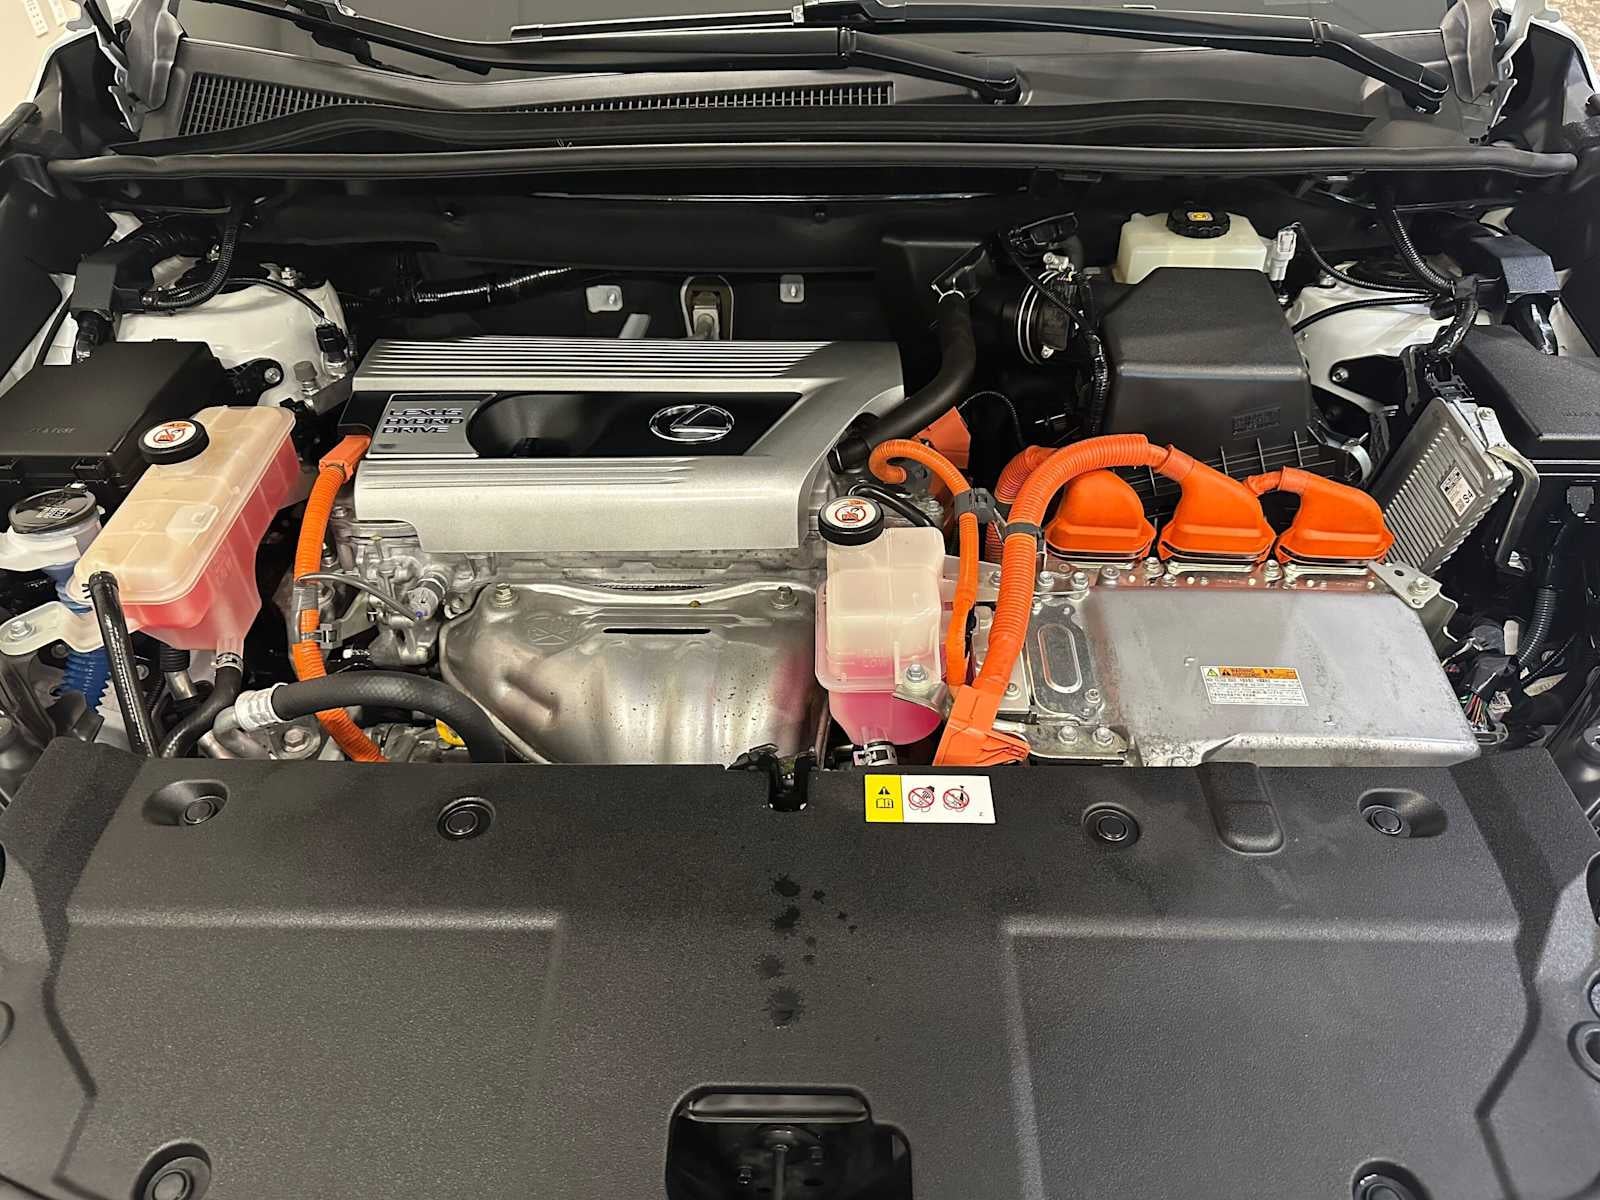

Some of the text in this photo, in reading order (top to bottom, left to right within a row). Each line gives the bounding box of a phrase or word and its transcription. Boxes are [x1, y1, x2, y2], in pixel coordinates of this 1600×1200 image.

[389, 408, 463, 416] LEXUS
[385, 416, 464, 425] HYBRID
[382, 425, 449, 433] DRIVE
